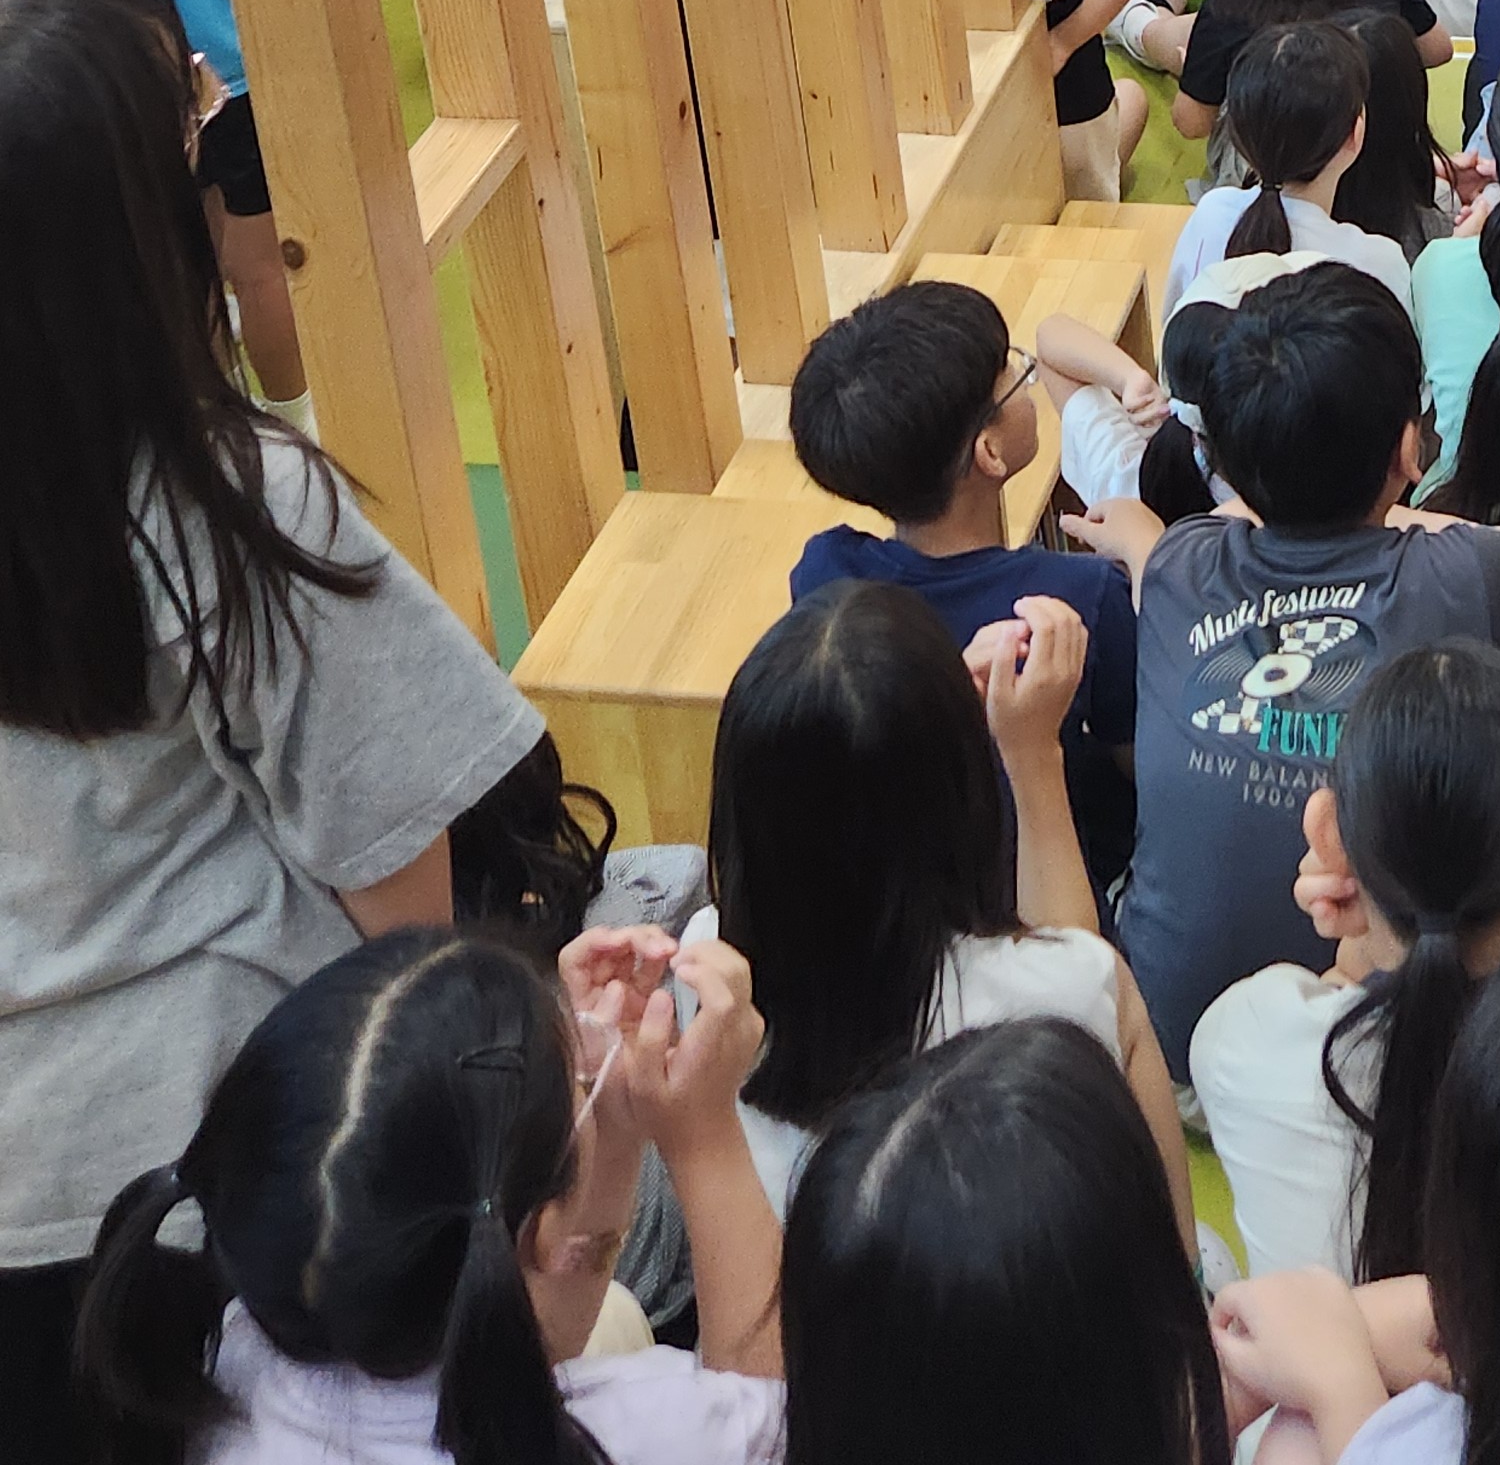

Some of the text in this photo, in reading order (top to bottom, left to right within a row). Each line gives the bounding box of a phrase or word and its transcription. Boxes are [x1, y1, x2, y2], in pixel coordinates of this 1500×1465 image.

[1257, 582, 1367, 628] festival
[1188, 749, 1238, 779] NEW
[1242, 783, 1296, 809] 1906
